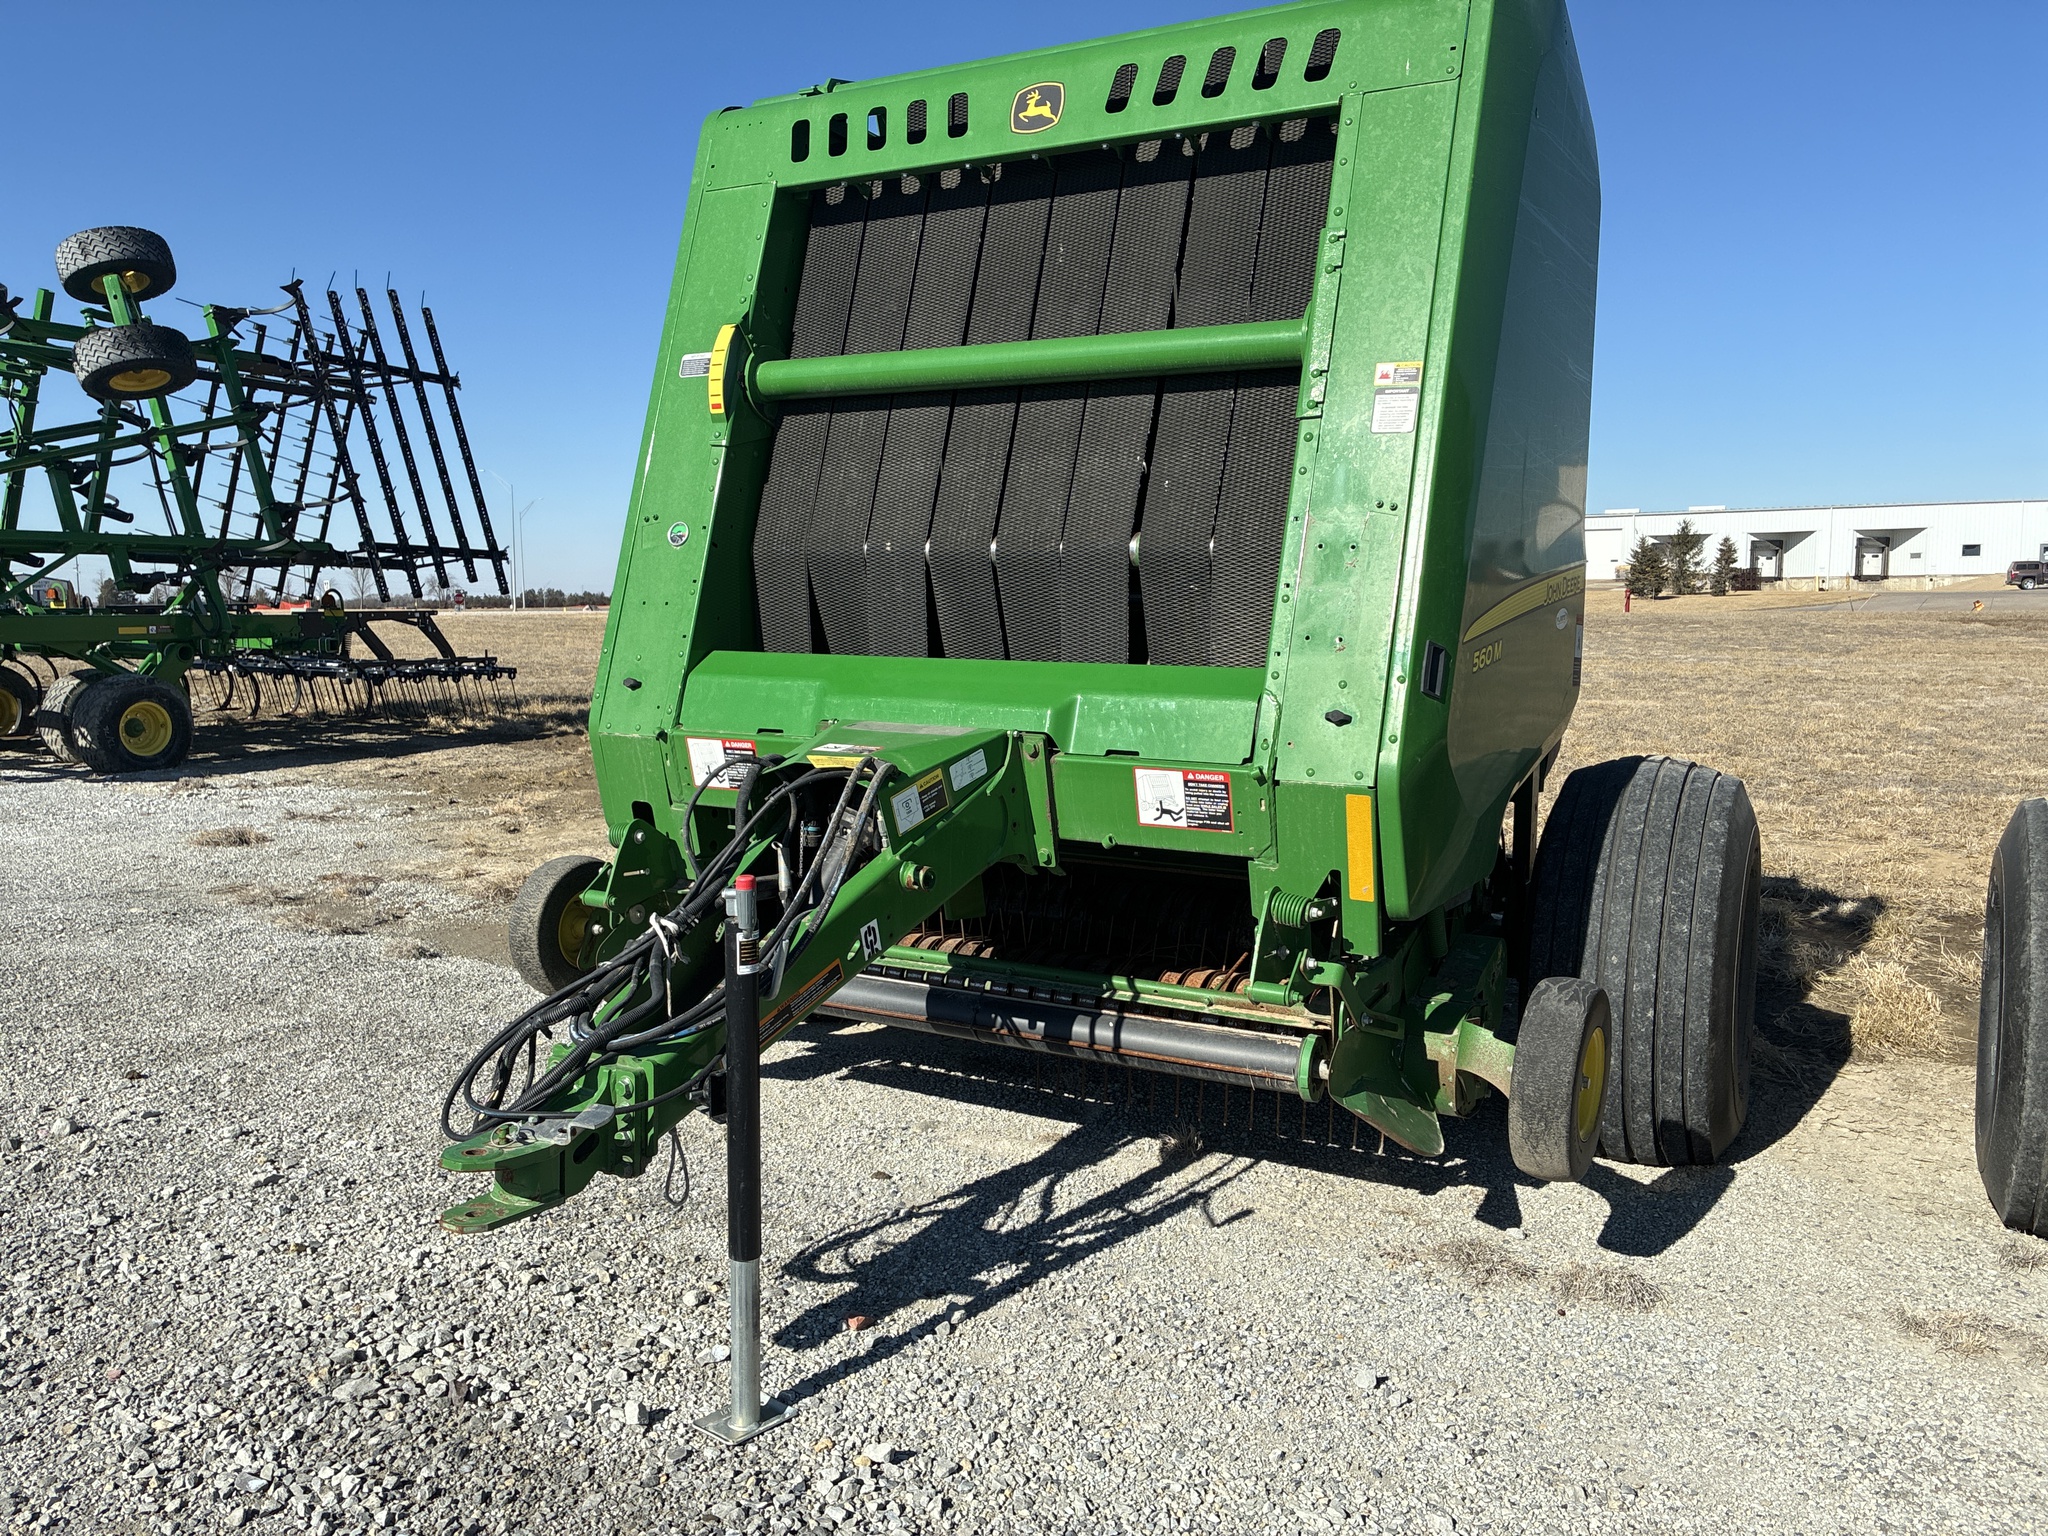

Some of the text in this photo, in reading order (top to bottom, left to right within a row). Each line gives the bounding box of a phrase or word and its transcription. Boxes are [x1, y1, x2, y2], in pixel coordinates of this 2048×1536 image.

[1543, 575, 1581, 606] JOHN DEERE
[1195, 773, 1224, 781] DANGER
